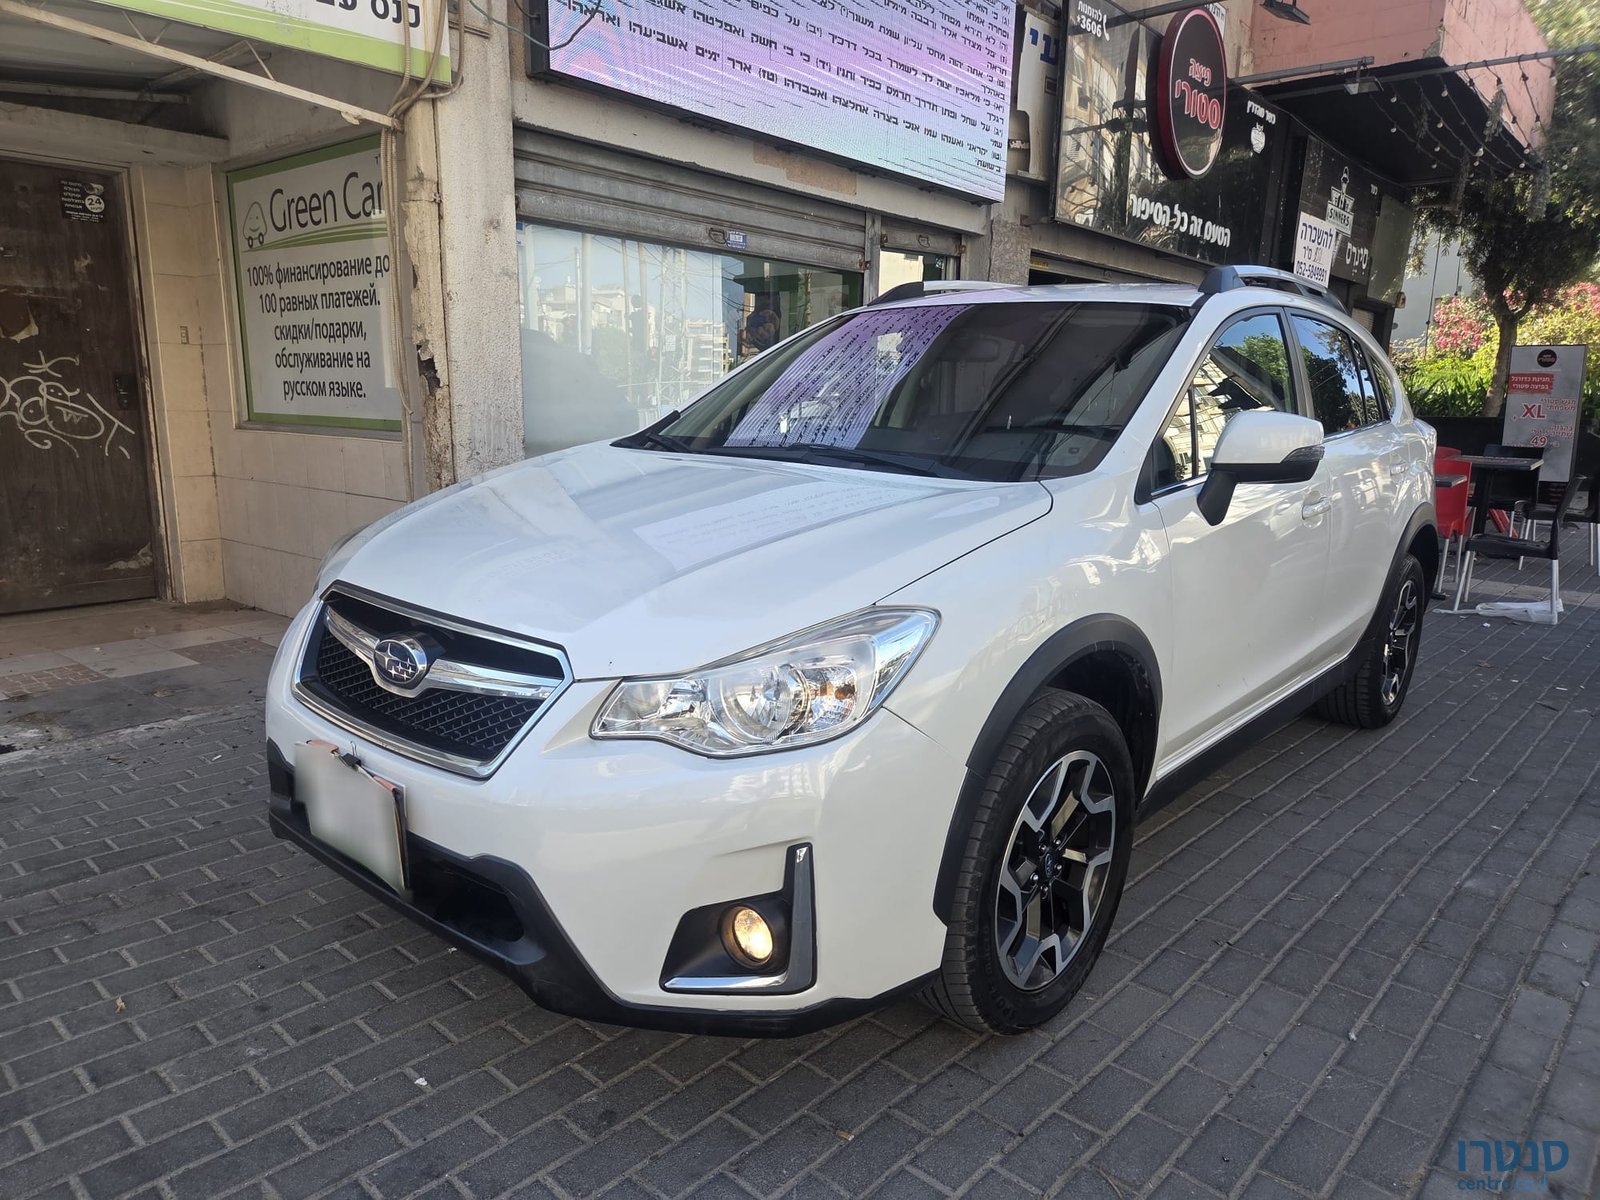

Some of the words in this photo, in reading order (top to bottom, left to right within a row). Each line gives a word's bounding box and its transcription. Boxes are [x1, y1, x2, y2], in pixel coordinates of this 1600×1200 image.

[693, 9, 745, 38] ואפלטהו
[784, 12, 800, 27] על
[910, 10, 937, 30] ורבבה
[939, 11, 960, 28] מפחד
[628, 20, 688, 52] אשביעהו
[878, 24, 900, 40] שמת
[964, 24, 982, 38] תירא
[828, 32, 858, 51] דרכיך
[904, 36, 922, 50] עליון
[986, 34, 996, 45] לא
[695, 45, 720, 62] ימים
[783, 45, 794, 57] בי
[800, 52, 811, 62] כי
[862, 46, 882, 62] בכל
[726, 56, 752, 74] ארך
[886, 56, 918, 76] לשמרך
[948, 56, 964, 69] יהוה
[986, 61, 1007, 76] תראה
[836, 66, 856, 81] ותנין
[922, 72, 933, 83] לך
[967, 65, 984, 78] אתה
[986, 74, 994, 82] כי
[1188, 58, 1212, 87] פיצה
[784, 77, 828, 101] ואכבדהו
[860, 75, 882, 91] כפיר
[980, 84, 1006, 100] באהלך
[832, 94, 869, 115] אחלצהו
[983, 98, 991, 106] כי
[1174, 79, 1221, 130] סטורי
[872, 109, 899, 126] בצרה
[986, 112, 1004, 124] רגלך
[1266, 110, 1276, 125] כשר
[902, 119, 920, 133] אנכי
[924, 127, 938, 139] עמו
[980, 122, 990, 132] על
[88, 198, 102, 206] 24
[269, 188, 338, 232] Green
[1130, 194, 1171, 227] הסיפור
[1173, 204, 1188, 233] כל
[1189, 215, 1204, 238] זה
[1300, 222, 1334, 250] להשכרה
[247, 264, 274, 288] 100%
[276, 256, 372, 289] финансирование
[374, 254, 390, 278] до
[259, 293, 277, 314] 100
[279, 292, 320, 318] равных
[321, 282, 381, 310] платежей.
[274, 318, 368, 344] скидки/подарки,
[275, 347, 354, 374] обслуживание
[356, 350, 371, 368] на
[283, 380, 327, 401] русском
[328, 380, 366, 398] языке.
[1522, 404, 1546, 419] XL
[1531, 436, 1548, 448] 49
